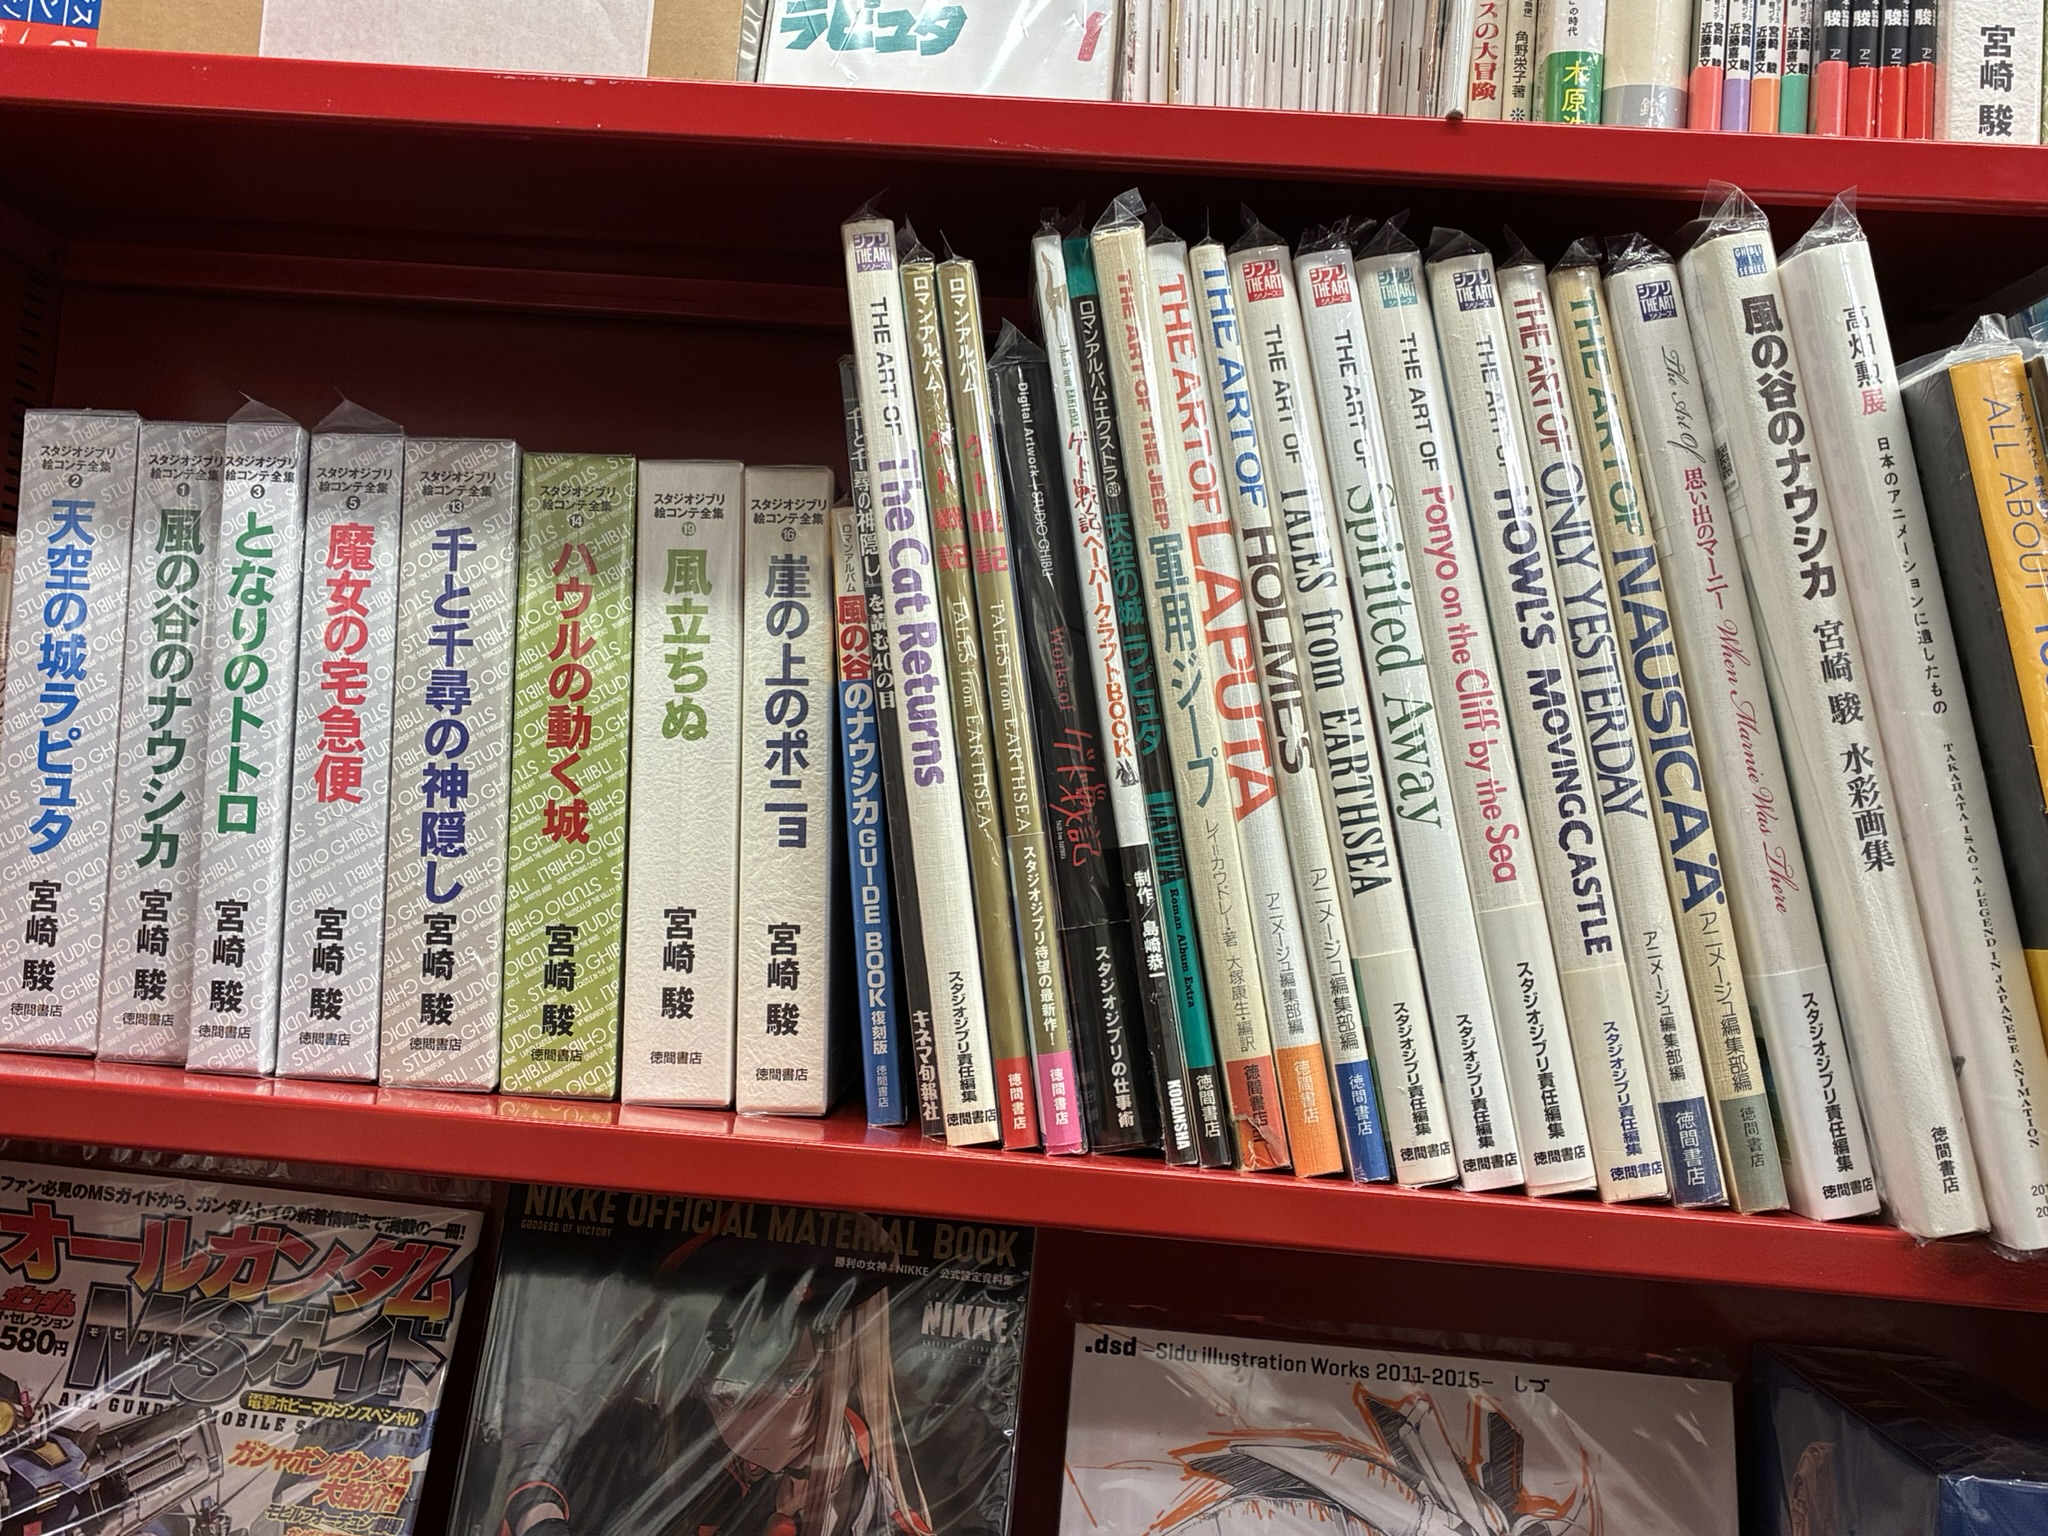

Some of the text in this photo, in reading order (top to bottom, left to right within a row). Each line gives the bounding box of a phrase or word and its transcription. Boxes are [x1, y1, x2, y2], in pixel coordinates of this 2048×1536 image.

[1512, 31, 1529, 98] 角野栄子著
[913, 276, 941, 391] ロマンアルバム
[949, 277, 978, 393] ロマンアルバム
[1017, 382, 1040, 477] Digital Artwork
[1400, 332, 1439, 471] THE ART OF
[1570, 289, 1611, 380] THE
[1609, 478, 1645, 537] OF
[41, 445, 116, 458] スタジオジブリ
[42, 459, 111, 473] 絵コンテ全集
[149, 454, 223, 468] スタジオジブリ
[151, 469, 218, 482] 絵コンテ全集
[225, 456, 297, 470] スタジオジブリ
[225, 470, 295, 483] 絵コンテ全集
[317, 467, 393, 481] スタジオジブリ
[420, 470, 497, 484] スタジオジブリ
[1741, 293, 1837, 601] 風の谷のナウシカ
[319, 481, 389, 495] 絵コンテ全集
[422, 484, 492, 498] 絵コンテ全集
[539, 485, 616, 498] スタジオジブリ
[542, 499, 612, 513] 絵コンテ全集
[653, 493, 725, 506] スタジオジブリ
[654, 507, 724, 520] 絵コンテ全集
[751, 498, 827, 511] スタジオジブリ
[754, 512, 824, 526] 絵コンテ全集
[1203, 259, 1314, 775] THE ART OF HOLMES
[842, 524, 857, 592] ロマンアルバム
[1158, 273, 1277, 824] THE ART OF LAPUTA
[1514, 291, 1648, 819] THE ART OF ONLY YESTERDAY
[1684, 467, 1730, 610] 思い出のマーニー
[888, 537, 931, 616] Cat
[1877, 436, 1947, 714] 日本のアニメーションに遺したもの
[29, 499, 96, 855] 天空の城ラピュタ
[217, 511, 276, 835] となりのトトロ
[313, 522, 376, 804] 魔女の宅急便
[661, 548, 712, 741] 風立ちぬ
[1148, 532, 1219, 808] 軍用ジープ
[1302, 607, 1344, 692] from
[1344, 484, 1442, 829] Spirited Away
[136, 508, 205, 869] 風の谷のナウシカ
[420, 527, 477, 904] 千と千尋の神隠し
[541, 543, 598, 845] ハウルの動く城
[764, 553, 811, 848] 崖の上のポニョ
[897, 621, 944, 787] Returns
[1422, 485, 1519, 884] Ponyo on the Cliff by the Sea
[1494, 486, 1613, 957] HOWL'S MOVING CASTLE
[1319, 706, 1392, 898] EARTHSEA
[1944, 743, 1969, 822] TAKAHATA
[1169, 888, 1195, 1008] Roman Album Extra
[1976, 888, 1998, 948] LEGEND
[1266, 892, 1304, 1035] アニメージュ編集部編
[1311, 867, 1360, 1052] アニメージュ編集部編
[1991, 951, 2002, 971] IN
[10, 1003, 63, 1017] 徳間書店
[122, 1012, 174, 1027] 徳間書店
[198, 1025, 251, 1040] 徳間書店
[1095, 945, 1135, 1128] スタジオジブリの仕事術
[1643, 930, 1686, 1082] アニメージュ編集部編
[1699, 911, 1753, 1093] アニメージュ編集部編
[1995, 974, 2019, 1054] JAPANESE
[299, 1032, 351, 1046] 徳間書店
[409, 1037, 462, 1051] 徳間書店
[530, 1048, 583, 1062] 徳間書店
[650, 1050, 703, 1065] 徳間書店
[912, 1010, 940, 1121] キネマ旬報社
[948, 971, 977, 1103] スタジオジブリ責任編集
[1393, 1001, 1431, 1136] スタジオジブリ責任編集
[1517, 961, 1565, 1140] スタジオジブリ責任編集
[755, 1067, 808, 1082] 徳間書店
[876, 1065, 889, 1108] 徳間書店
[1008, 1073, 1027, 1130] 徳間書店
[1049, 1068, 1069, 1126] 徳間書店
[1196, 1073, 1221, 1138] 徳間書店
[1294, 1059, 1319, 1124] 徳間書店
[1349, 1074, 1373, 1136] 徳間書店
[1456, 1014, 1495, 1149] スタジオジブリ責任編集
[1603, 1021, 1642, 1157] スタジオジブリ責任編集
[1802, 992, 1854, 1172] スタジオジブリ責任編集
[2012, 1058, 2041, 1148] ANIMATION
[947, 1109, 997, 1127] 徳間書店
[1167, 1079, 1191, 1150] KODANSHA
[1675, 1110, 1706, 1187] 徳間書店
[1740, 1105, 1765, 1169] 徳間書店
[1400, 1142, 1451, 1162] 徳間書店
[1462, 1152, 1518, 1173] 徳間書店
[1533, 1145, 1586, 1167] 徳間書店
[1610, 1161, 1664, 1182] 徳間書店
[1931, 1126, 1960, 1194] 徳間書店
[1822, 1176, 1874, 1200] 徳間書店
[521, 1219, 613, 1238] GODDESS OF VICTORY
[627, 1192, 758, 1240] OFFICIAL
[767, 1205, 919, 1257] MATERIAL
[933, 1223, 1019, 1268] BOOK
[921, 1301, 1008, 1344] NIKKE
[1085, 1334, 1137, 1357] .dsd
[1202, 1346, 1307, 1374] illustration
[1310, 1356, 1370, 1379] Works
[1514, 1375, 1550, 1394] しづ
[247, 1392, 421, 1427] 電撃ホビーマガジンスペシャル
